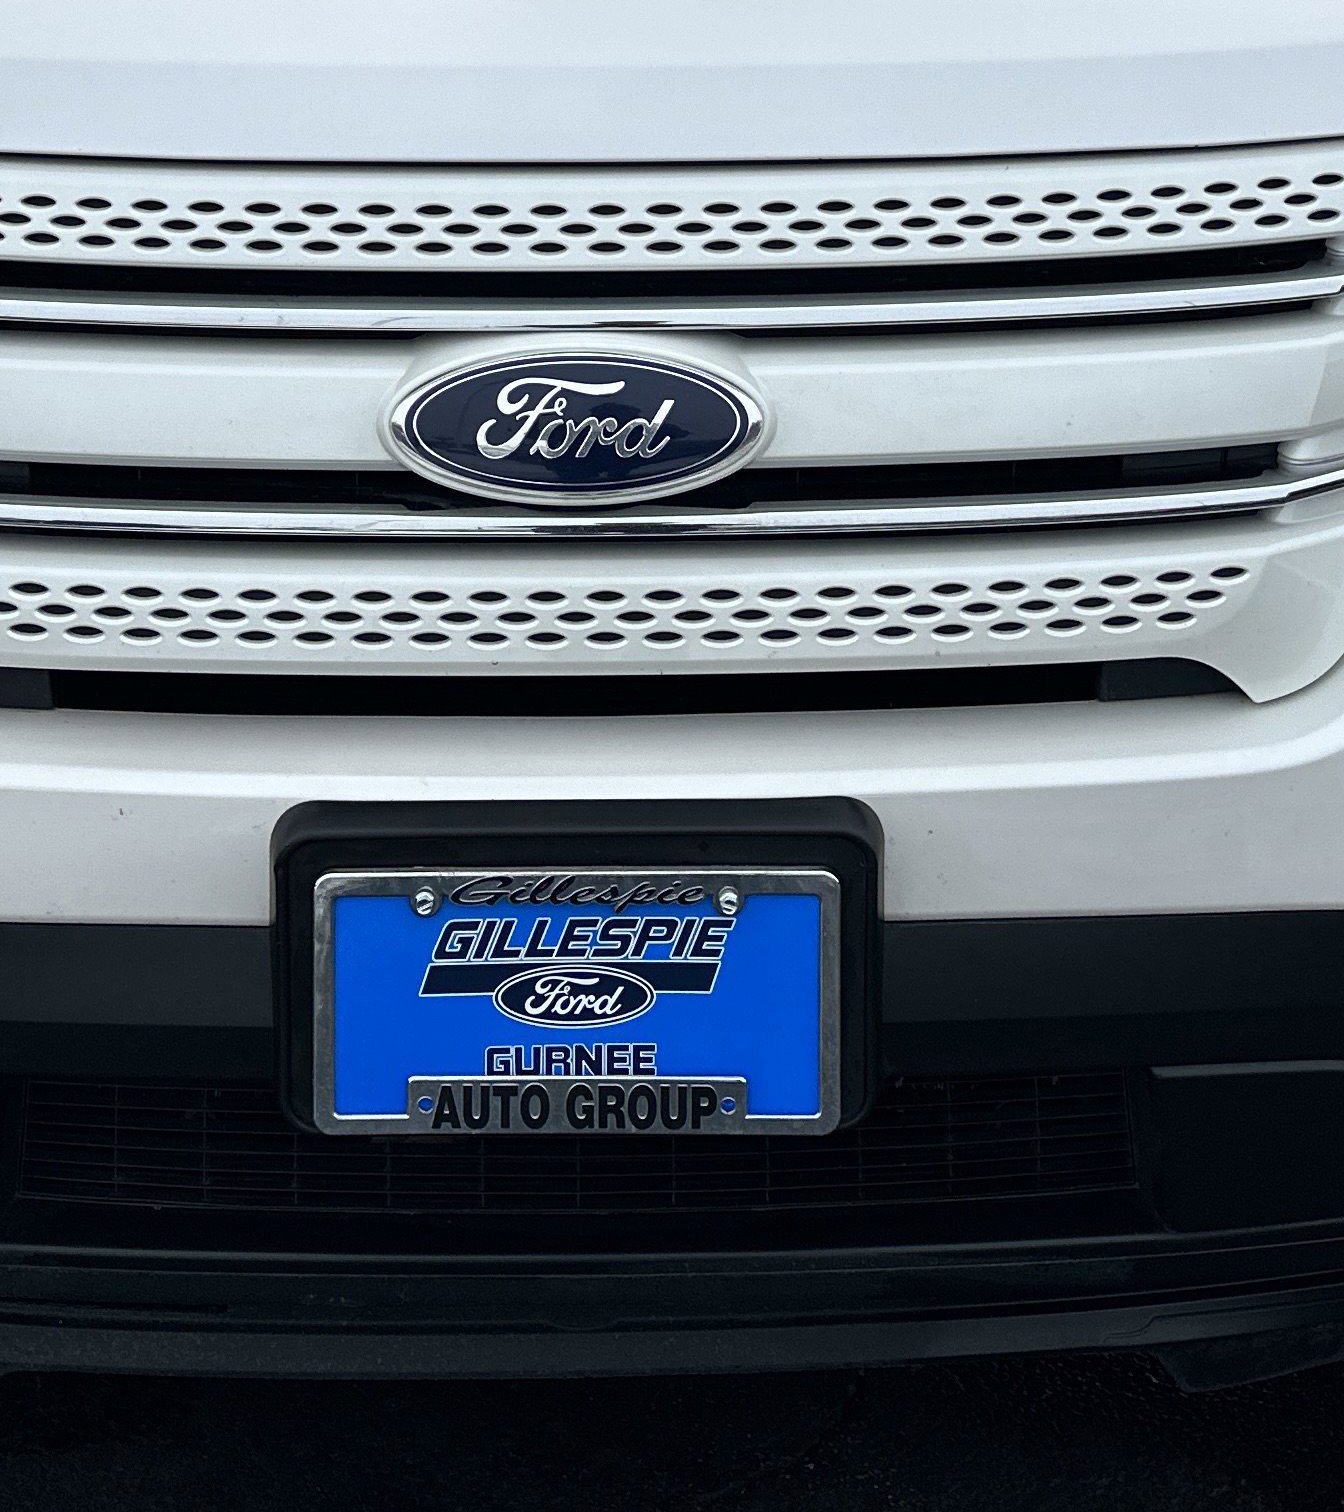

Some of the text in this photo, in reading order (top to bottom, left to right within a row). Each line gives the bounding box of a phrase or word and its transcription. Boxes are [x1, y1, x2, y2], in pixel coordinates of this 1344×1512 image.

[476, 376, 675, 460] Ford
[449, 875, 706, 913] Gillespie
[432, 917, 736, 962] GILLESPIE
[524, 974, 624, 1017] Ford
[484, 1042, 658, 1077] GURNEE
[431, 1082, 718, 1130] AUTO GROUP
